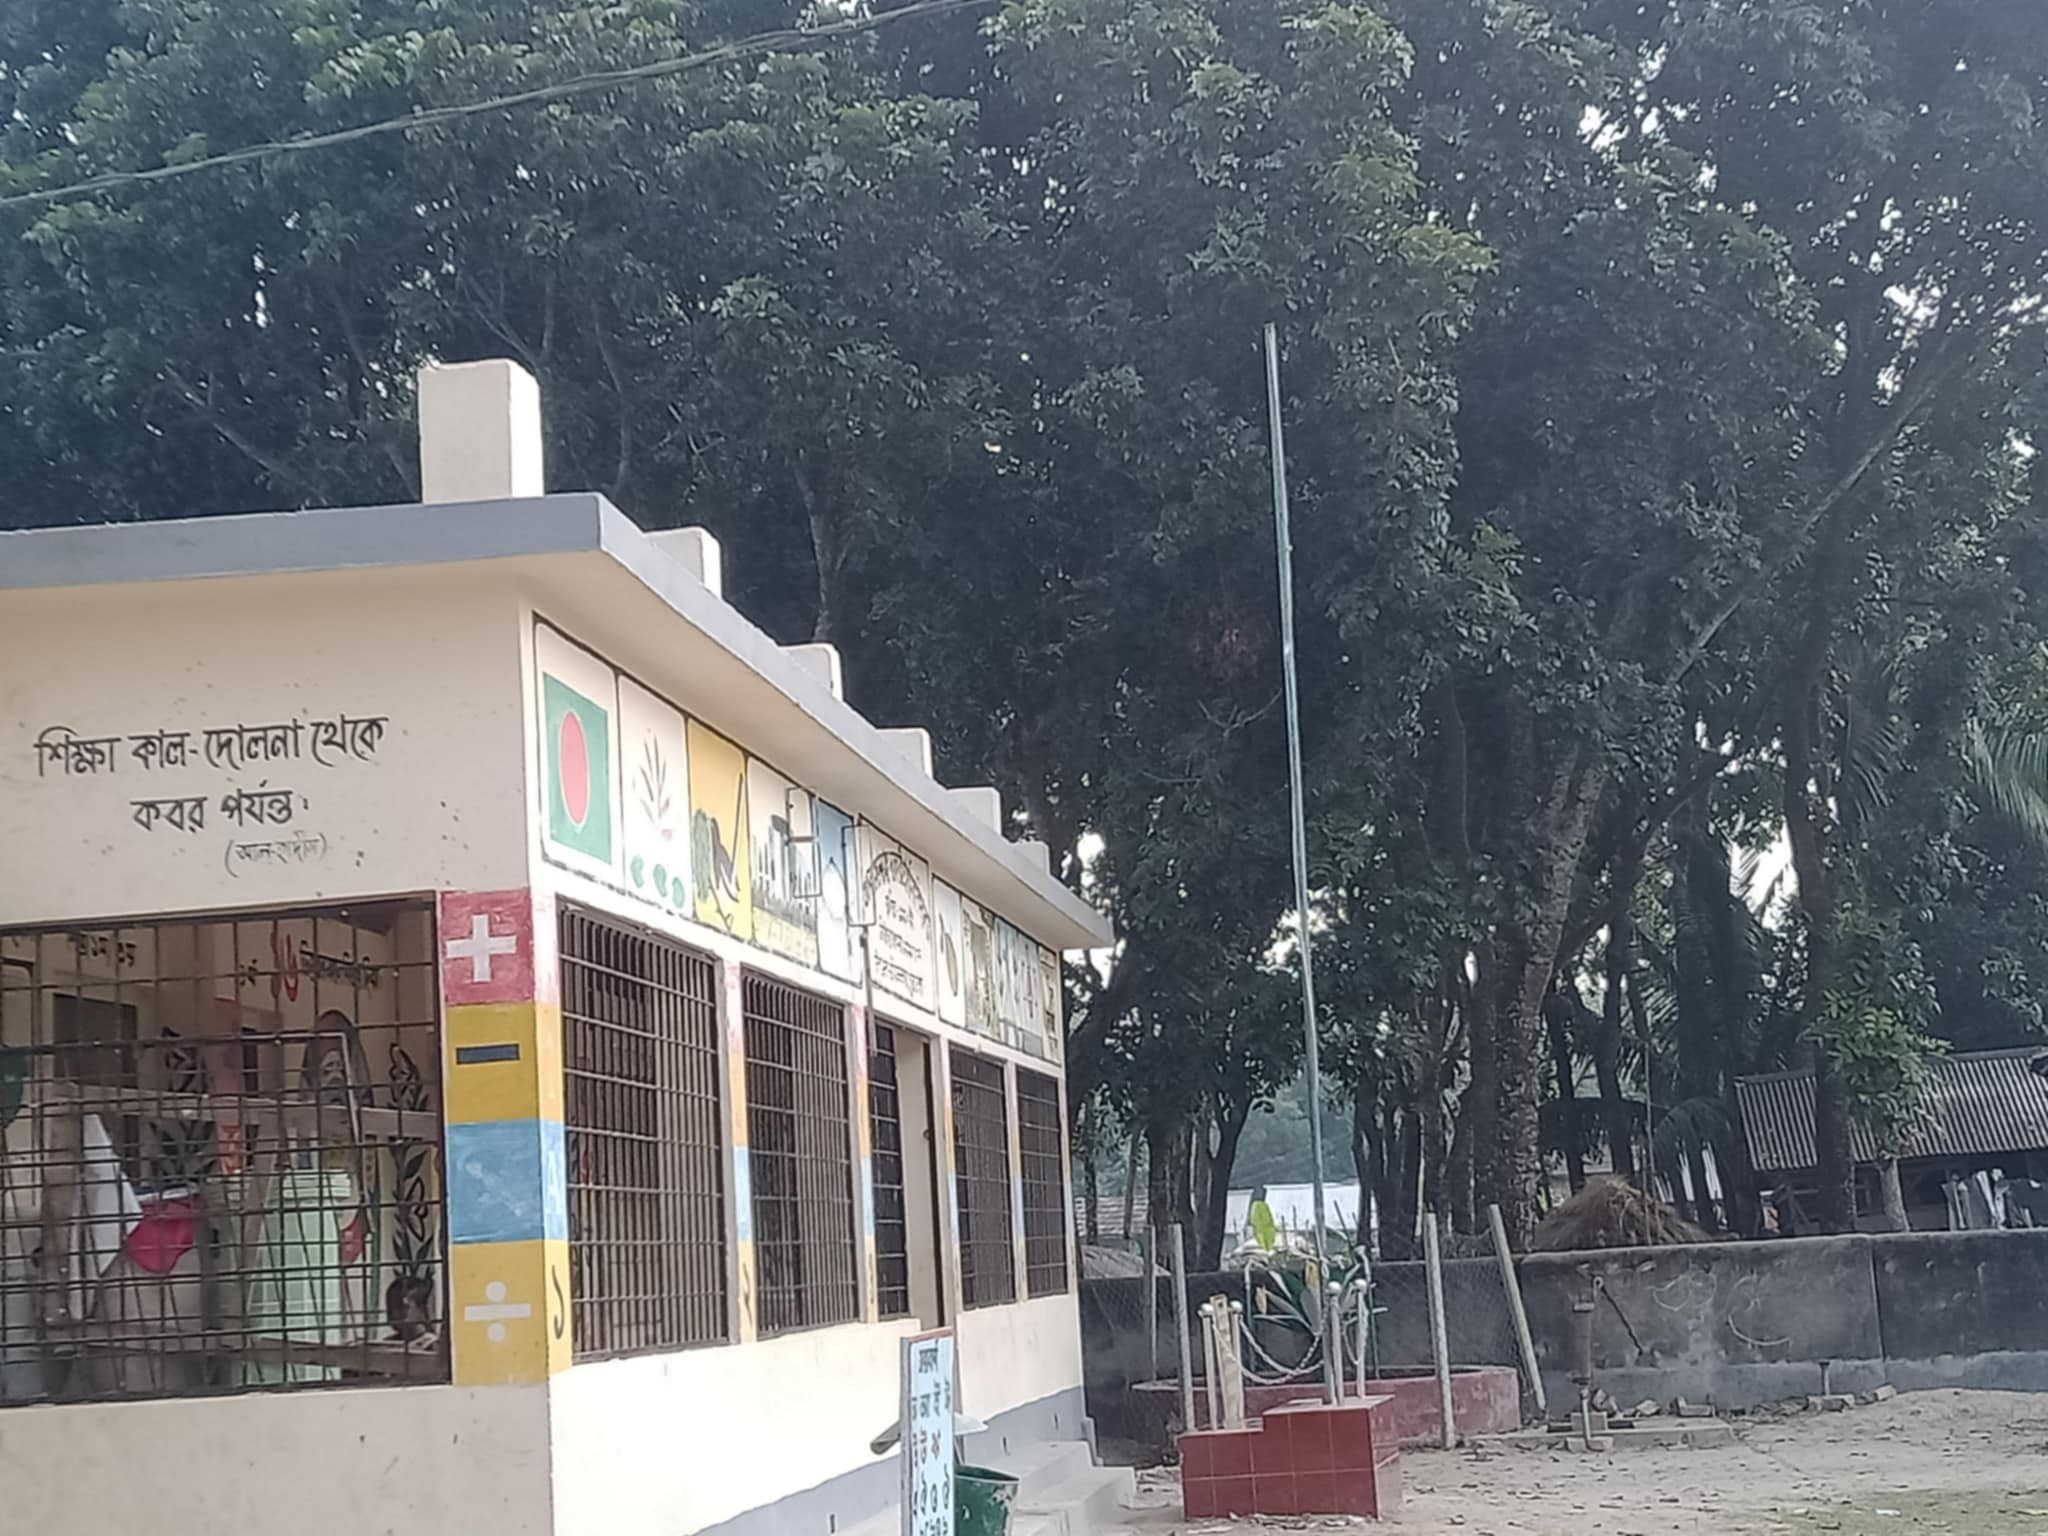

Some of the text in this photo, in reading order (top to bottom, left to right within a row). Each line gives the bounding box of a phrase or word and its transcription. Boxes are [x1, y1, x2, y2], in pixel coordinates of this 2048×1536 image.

[33, 726, 122, 777] শিক্ষা
[310, 714, 389, 767] থেকে
[130, 796, 208, 833] কবর
